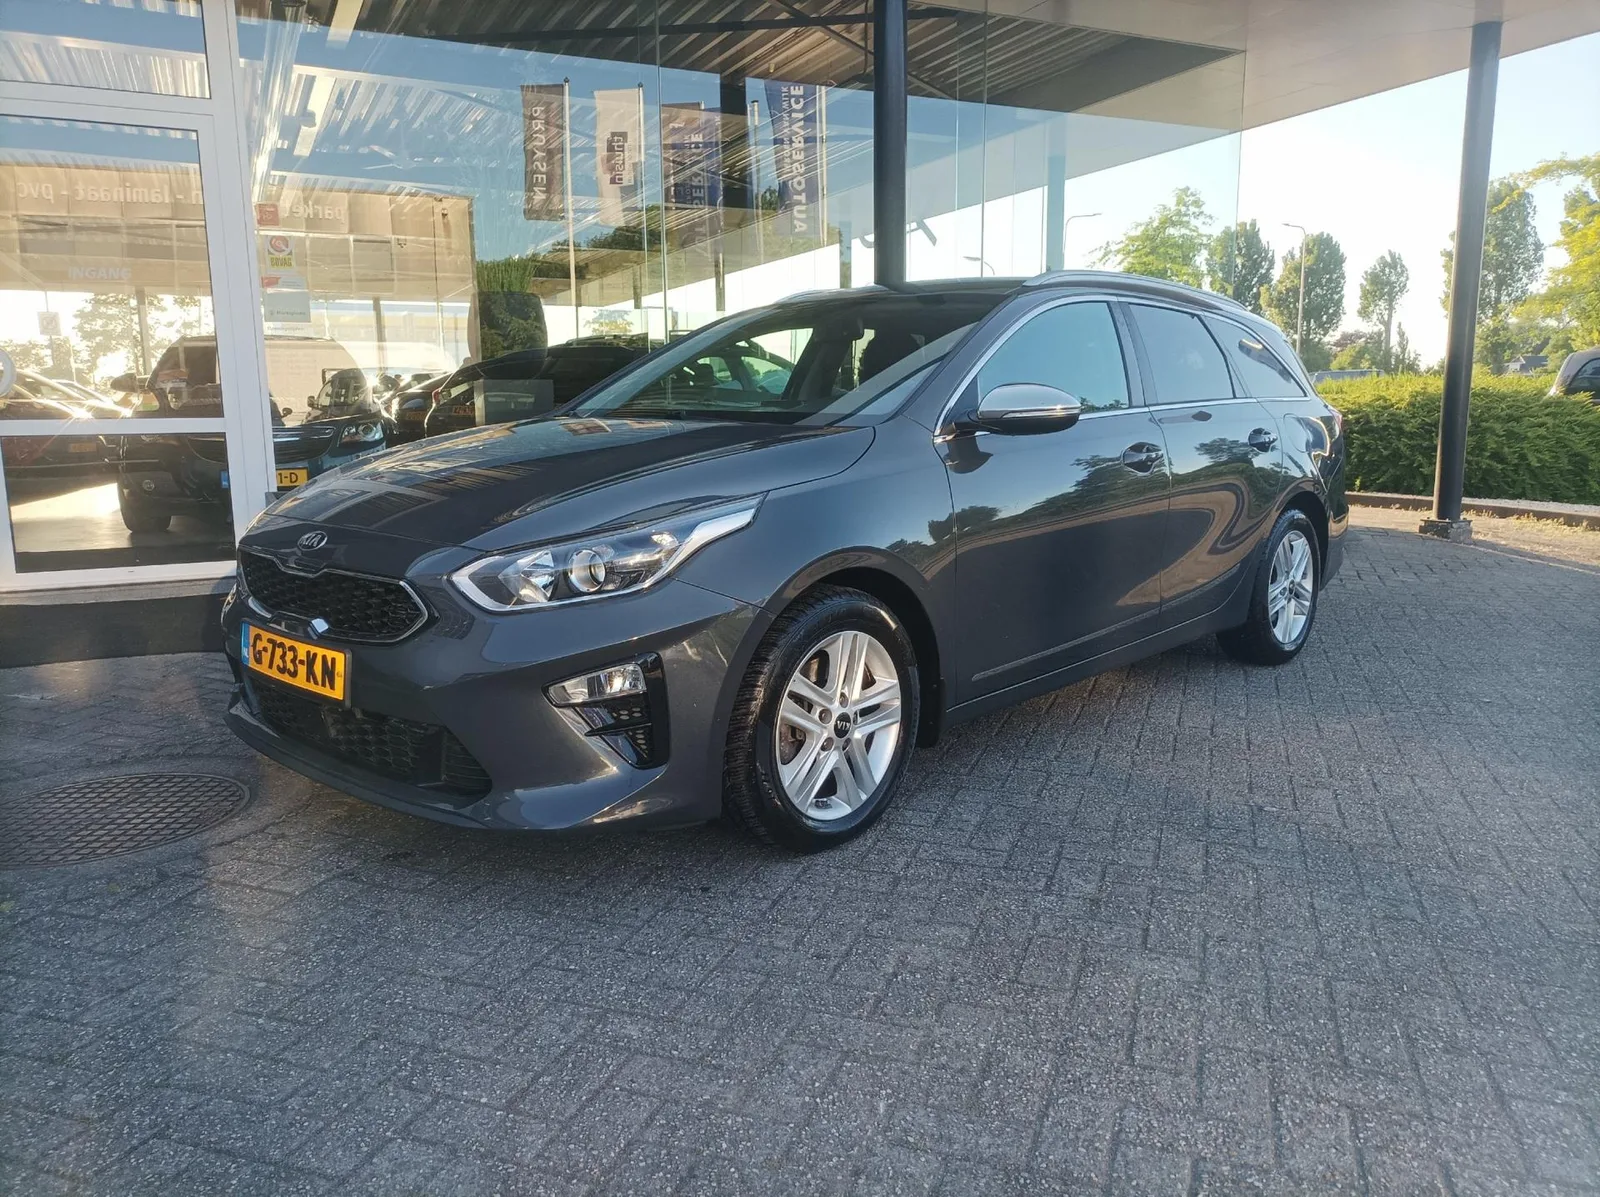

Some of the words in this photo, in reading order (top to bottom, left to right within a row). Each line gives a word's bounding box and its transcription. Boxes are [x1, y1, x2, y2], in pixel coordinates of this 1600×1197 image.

[270, 256, 293, 267] BOVAG
[68, 266, 132, 280] INGANG
[277, 472, 299, 484] 1-D
[300, 533, 322, 547] KIA
[251, 632, 337, 691] G-733-KN
